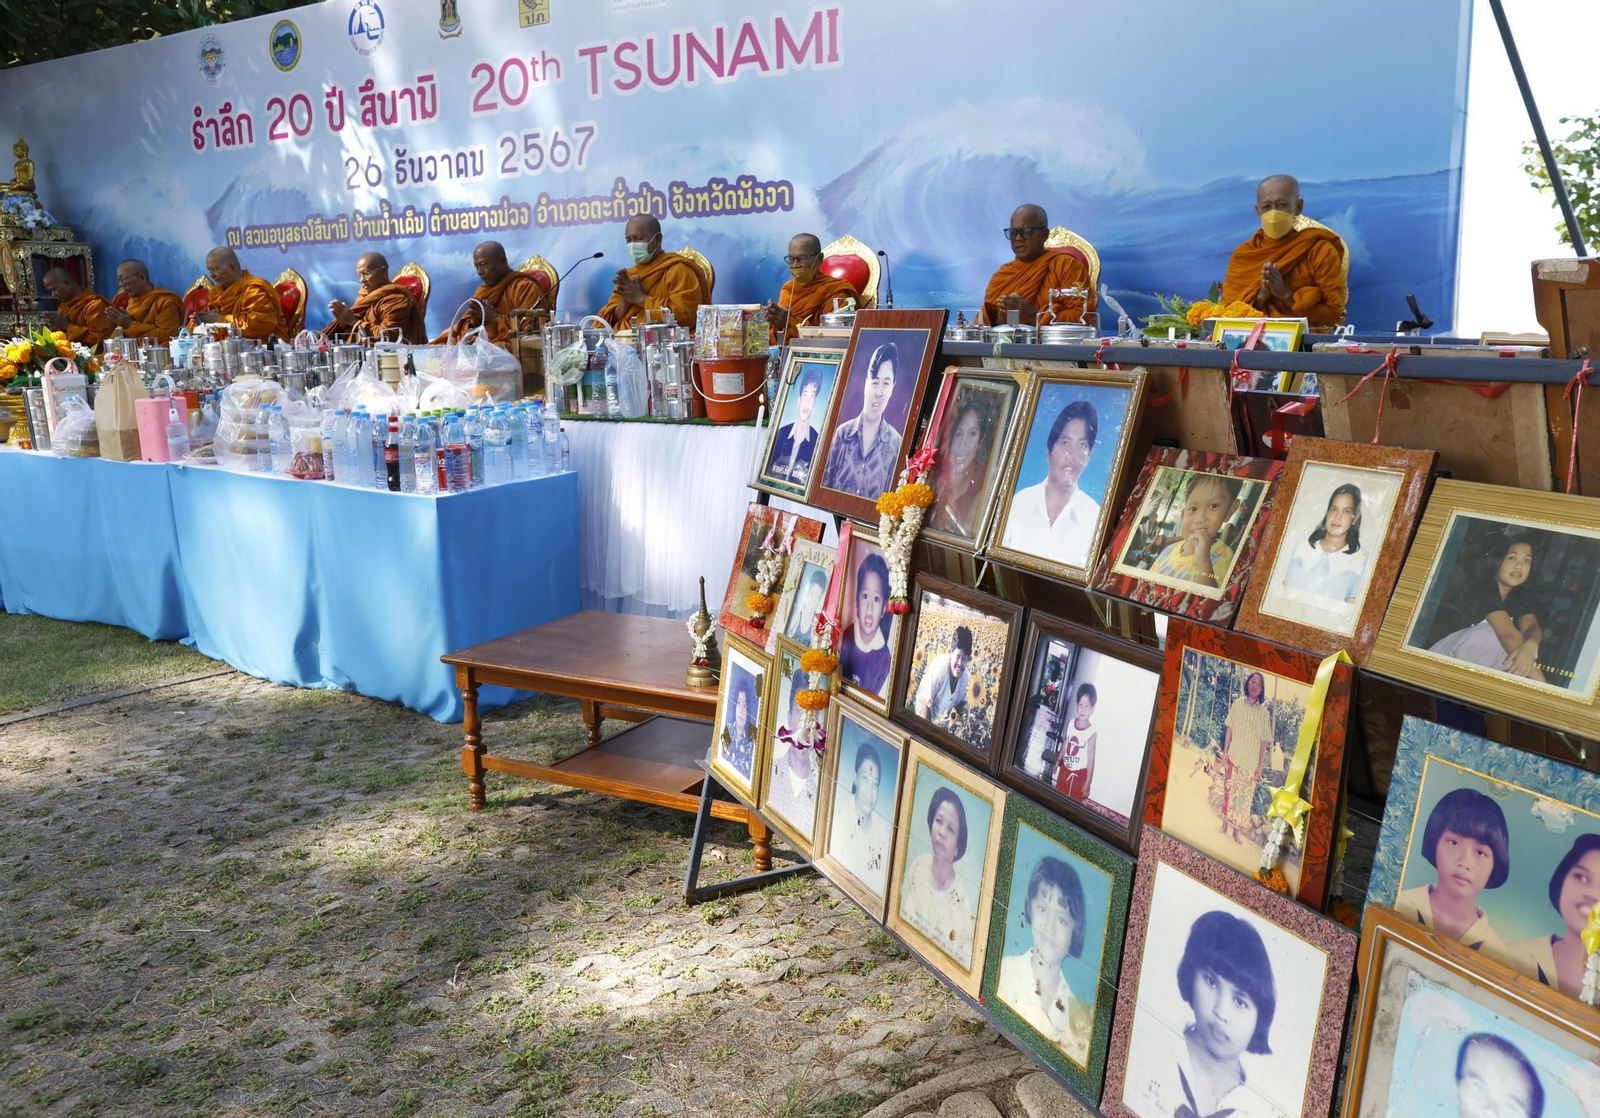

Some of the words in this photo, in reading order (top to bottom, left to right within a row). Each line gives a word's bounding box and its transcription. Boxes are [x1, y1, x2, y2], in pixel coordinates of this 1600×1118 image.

[192, 102, 254, 150] รำลึก
[267, 93, 313, 141] 20
[325, 86, 345, 132] ปี
[359, 74, 438, 128] สึนามิ
[470, 50, 561, 112] 20th
[578, 9, 839, 95] TSUNAMI
[344, 155, 382, 190] 26
[395, 148, 484, 185] ธันวาคม
[500, 125, 595, 174] 2567
[228, 230, 241, 247] ณ
[245, 217, 348, 250] สวนอนุสรณ์สึนามิ
[354, 202, 425, 238] บ้านน้ำเค็ม
[431, 200, 529, 232] ตำบลบางม่วง
[537, 182, 663, 224] อำเภอตะกั่วป่า
[672, 180, 790, 214] จังหวัดพังงา
